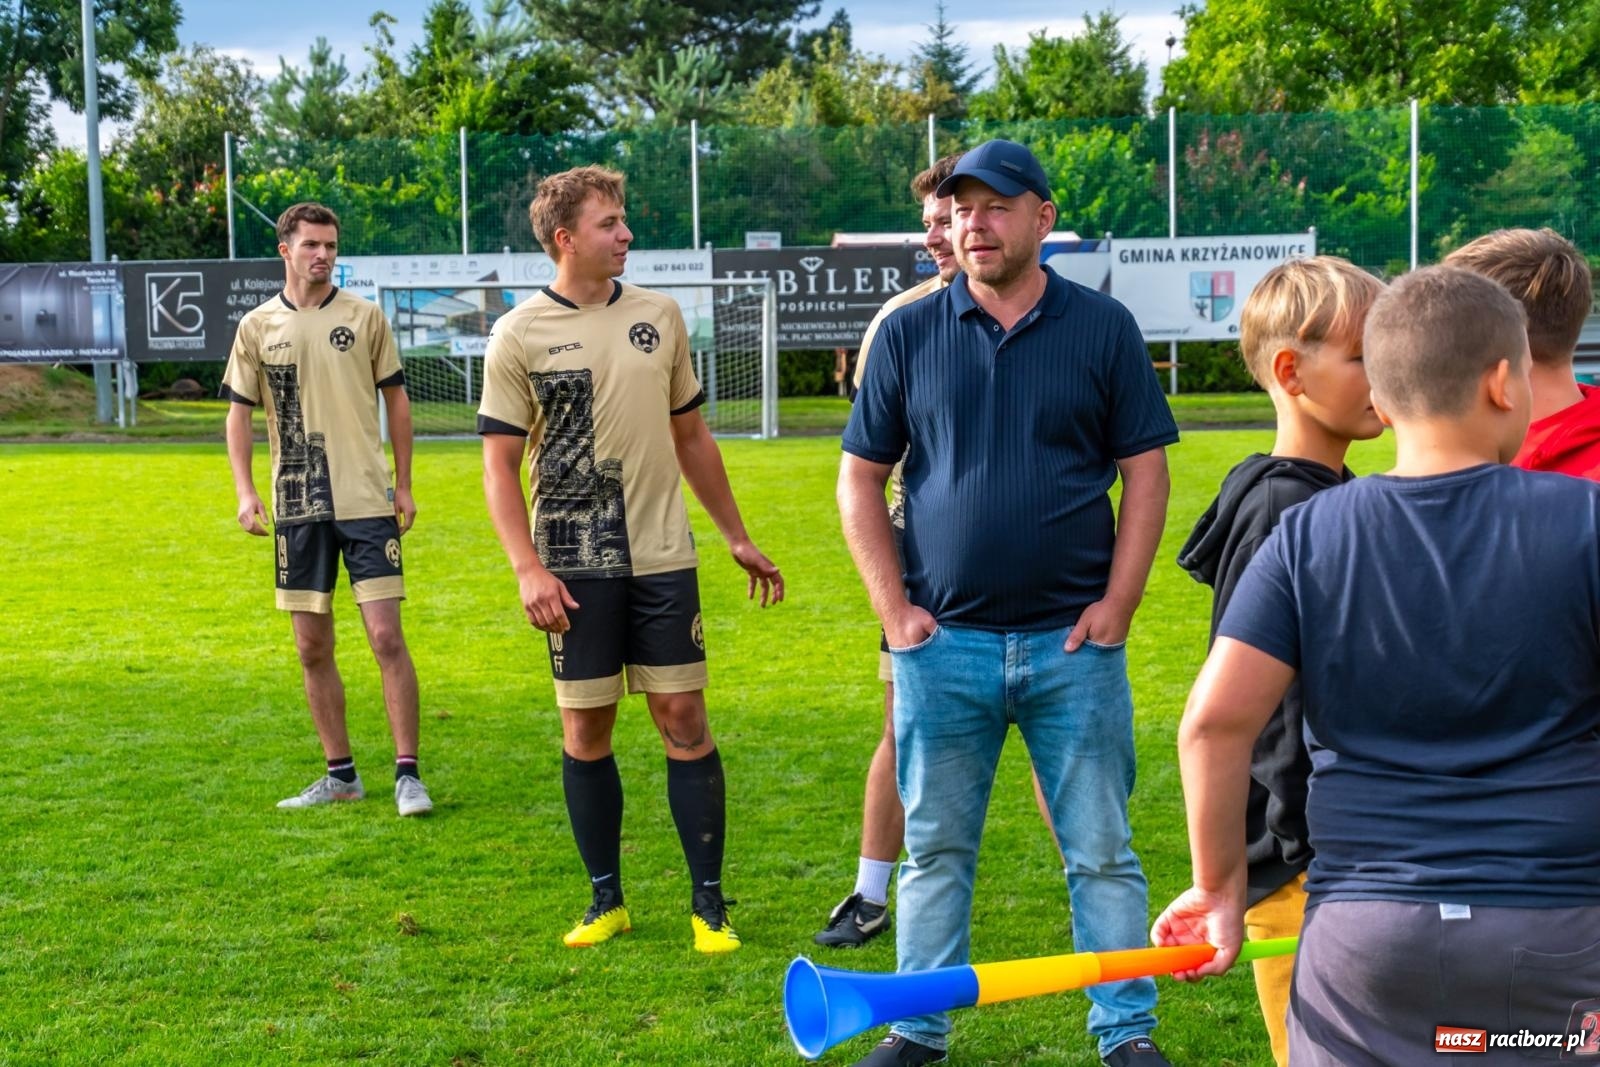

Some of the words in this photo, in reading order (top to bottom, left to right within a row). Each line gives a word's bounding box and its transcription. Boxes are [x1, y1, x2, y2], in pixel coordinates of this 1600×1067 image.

[1119, 248, 1176, 264] GMINA
[1181, 242, 1306, 263] KRZYŻANOWICE
[346, 279, 375, 288] OKNA
[150, 277, 204, 333] K5
[226, 294, 258, 306] 47-450
[780, 301, 846, 313] POŚPIECH
